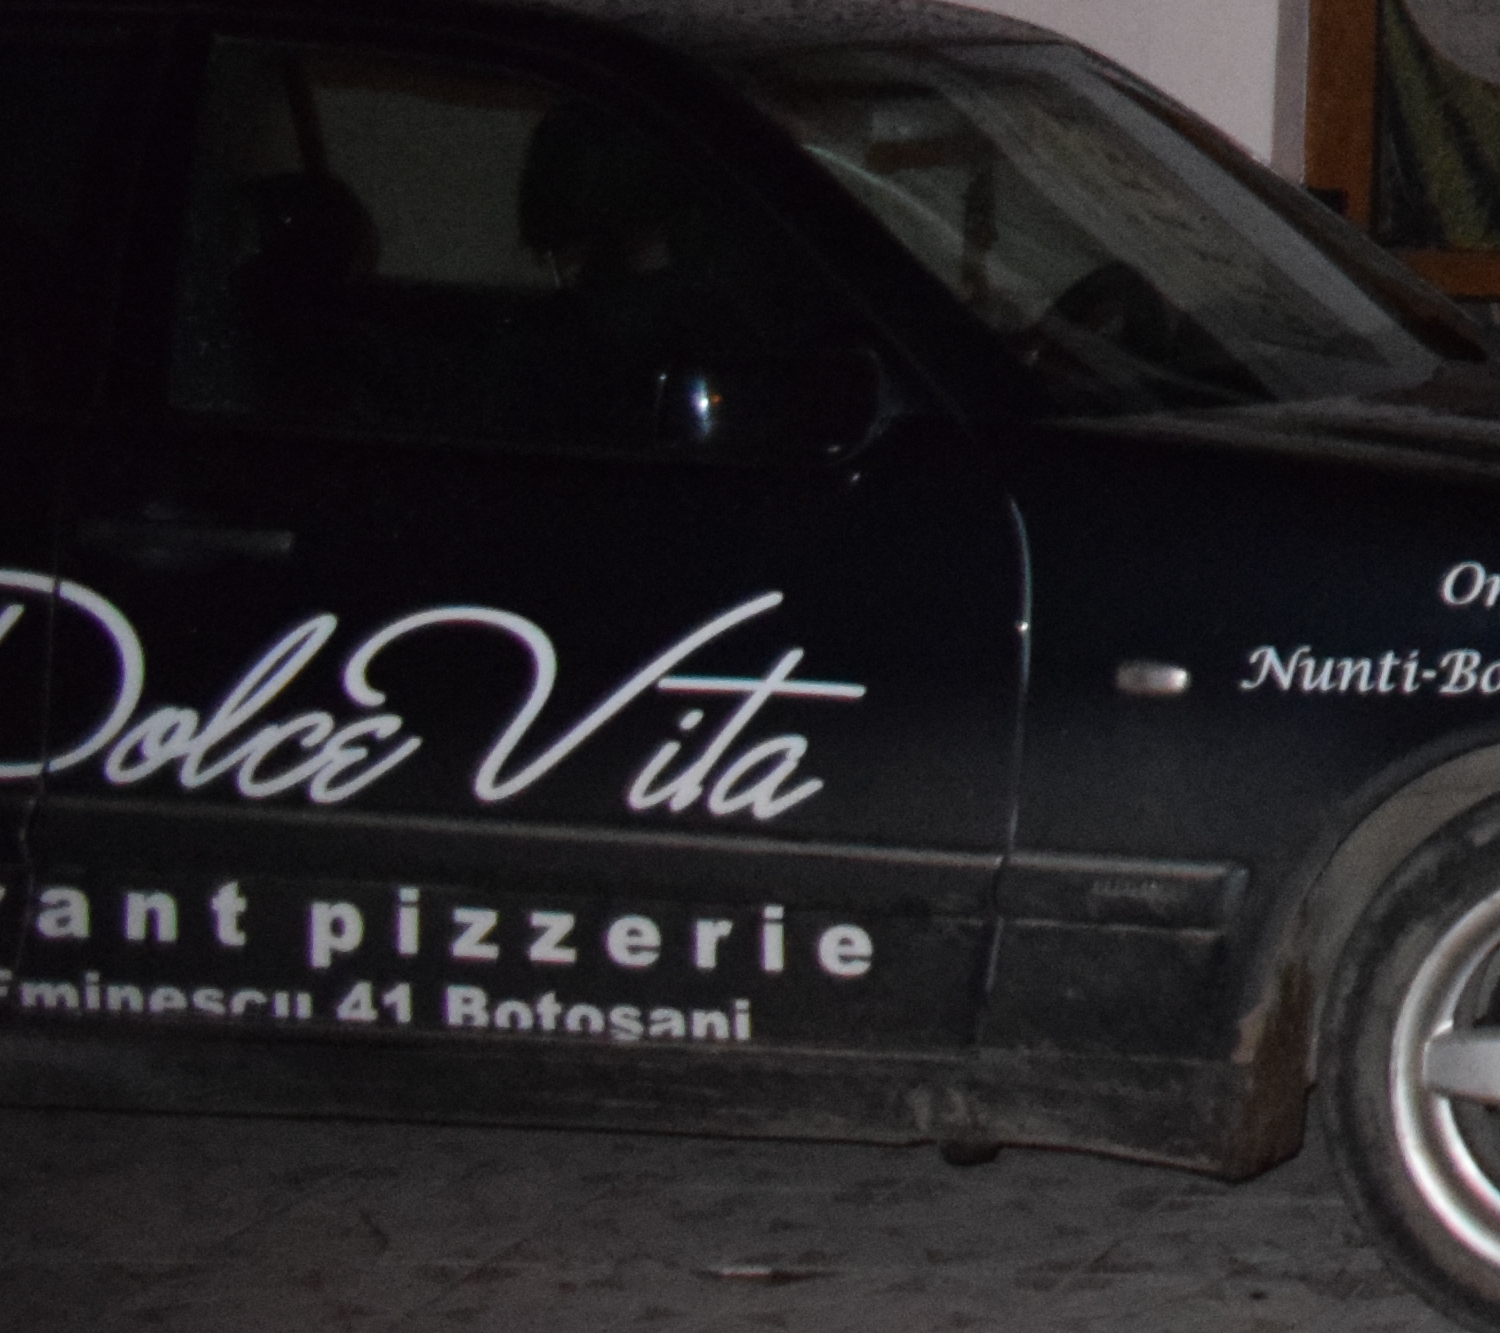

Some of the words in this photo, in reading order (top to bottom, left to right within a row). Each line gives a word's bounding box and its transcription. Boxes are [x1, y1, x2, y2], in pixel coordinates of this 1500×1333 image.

[342, 589, 868, 822] Vita
[0, 879, 249, 949] ant
[307, 885, 876, 978] pizzerie
[335, 978, 415, 1026] 41
[444, 983, 752, 1044] Botosani
